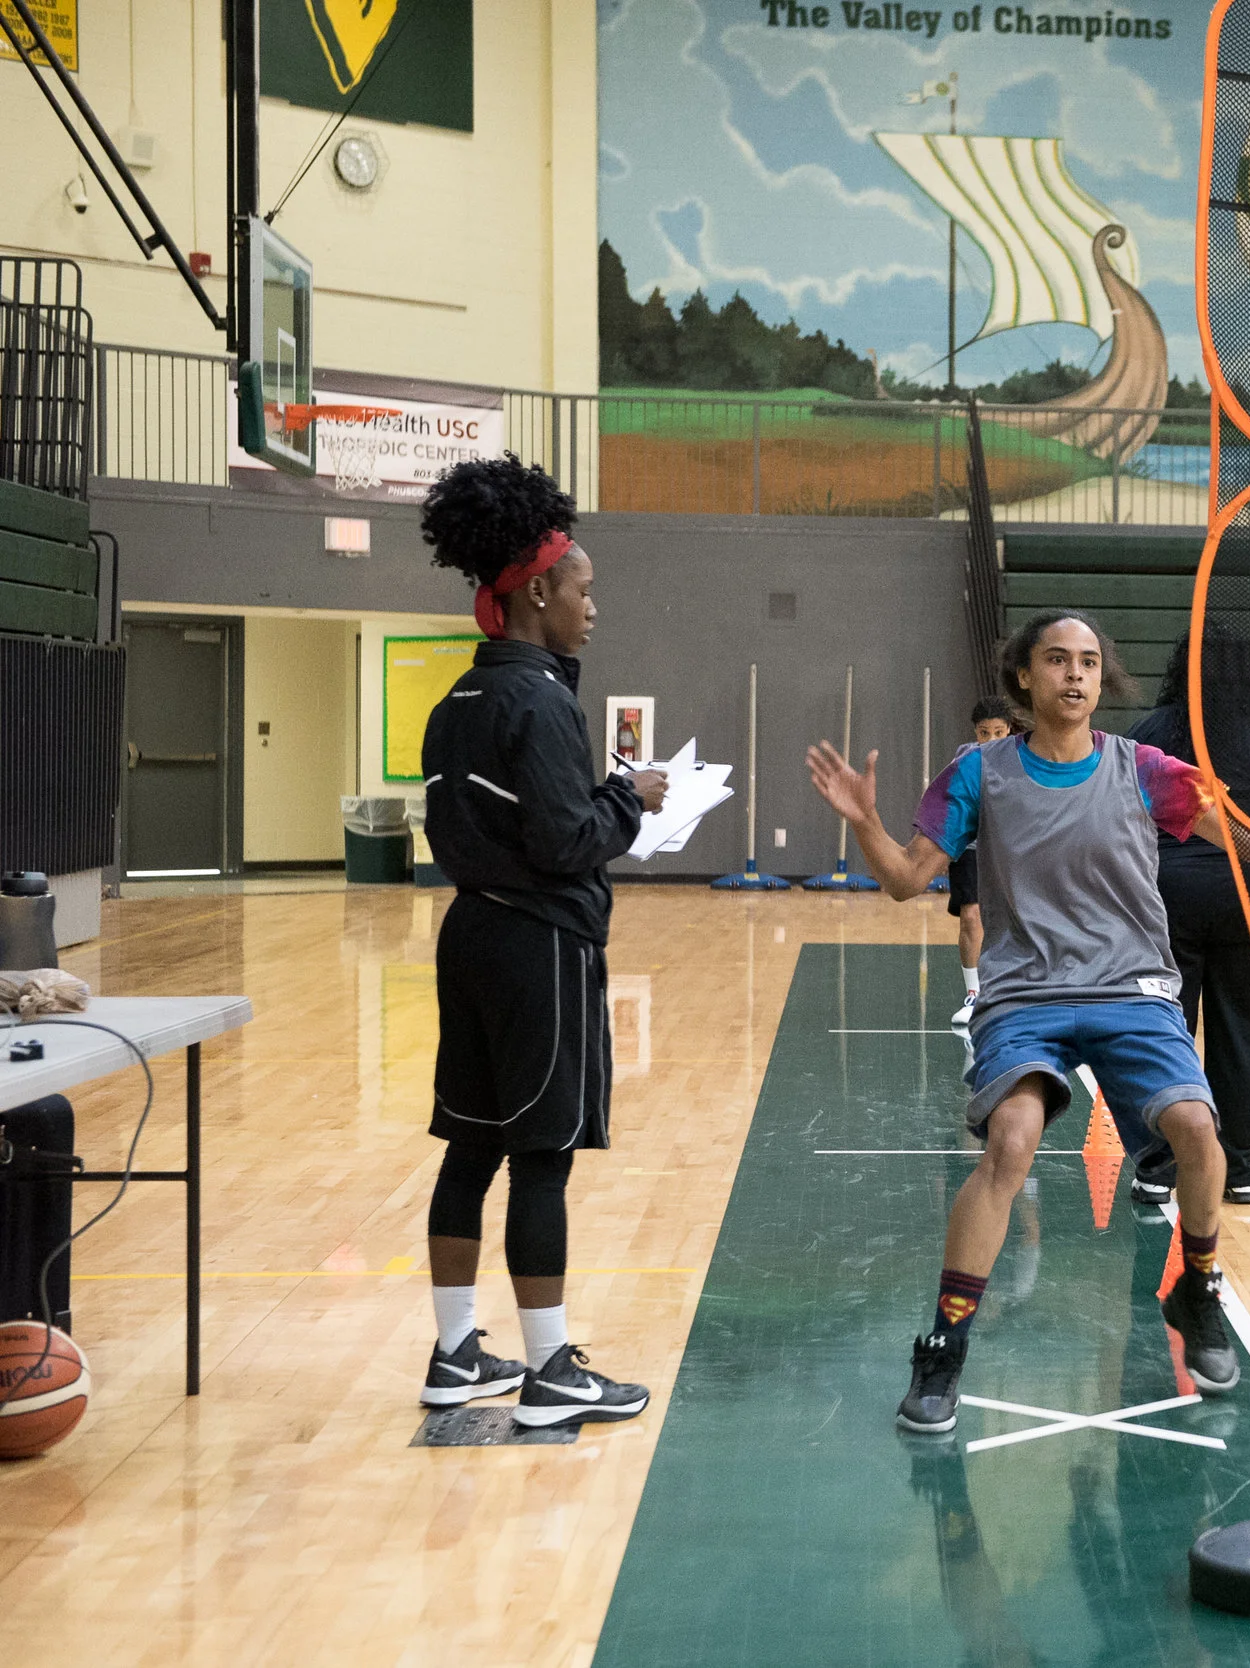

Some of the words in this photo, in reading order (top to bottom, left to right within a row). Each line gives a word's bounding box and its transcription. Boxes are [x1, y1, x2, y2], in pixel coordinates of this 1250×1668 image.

[760, 0, 830, 28] The
[841, 1, 942, 39] Valley
[953, 5, 983, 32] of
[994, 6, 1172, 42] Champions
[436, 417, 479, 440] USC
